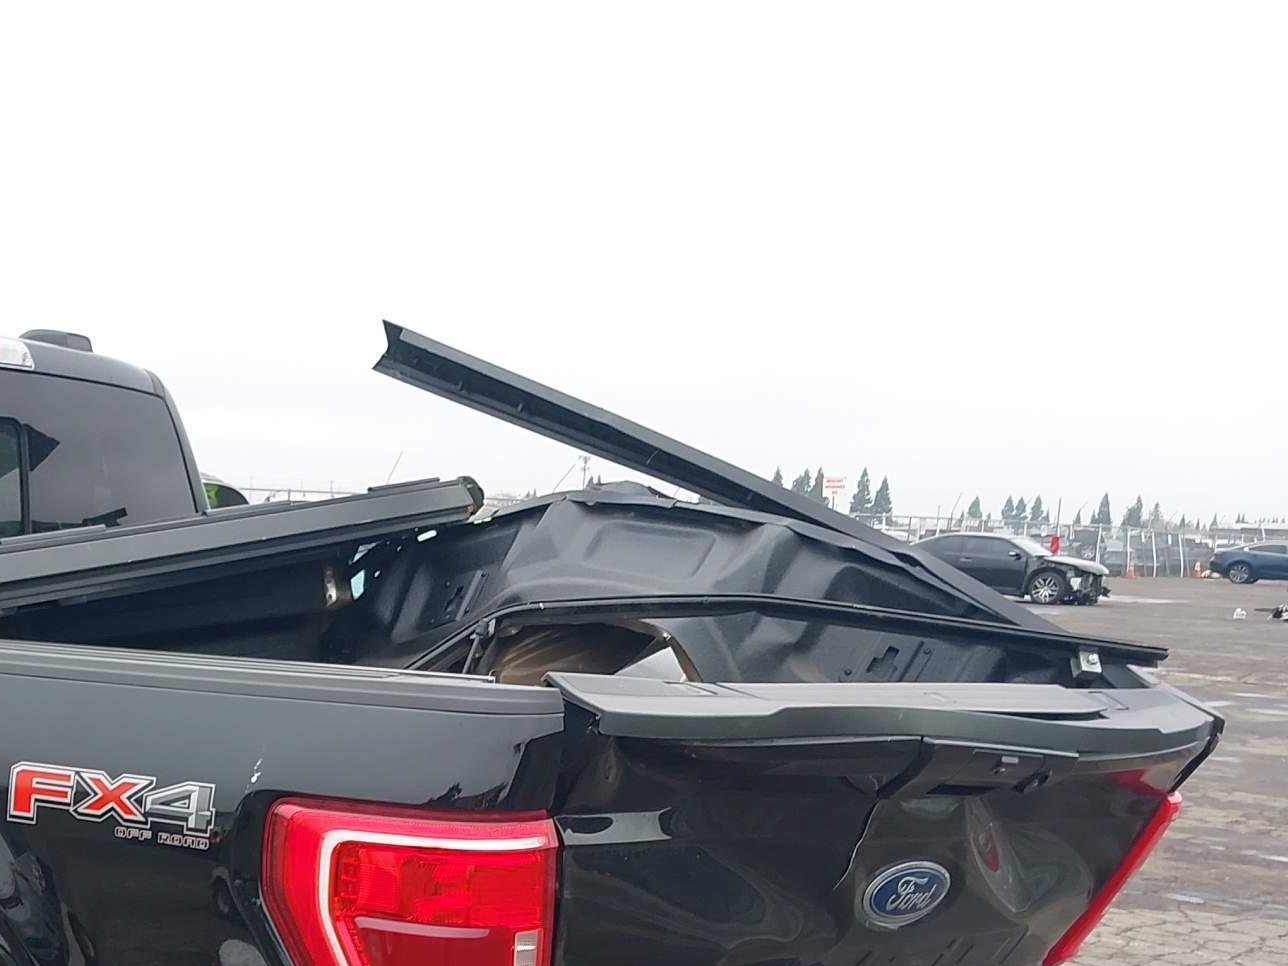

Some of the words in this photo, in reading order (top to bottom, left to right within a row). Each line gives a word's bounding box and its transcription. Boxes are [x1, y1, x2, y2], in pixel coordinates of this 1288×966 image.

[6, 760, 216, 836] FX4
[114, 826, 153, 841] OFF
[157, 832, 210, 850] ROAD
[885, 875, 937, 912] Ford
